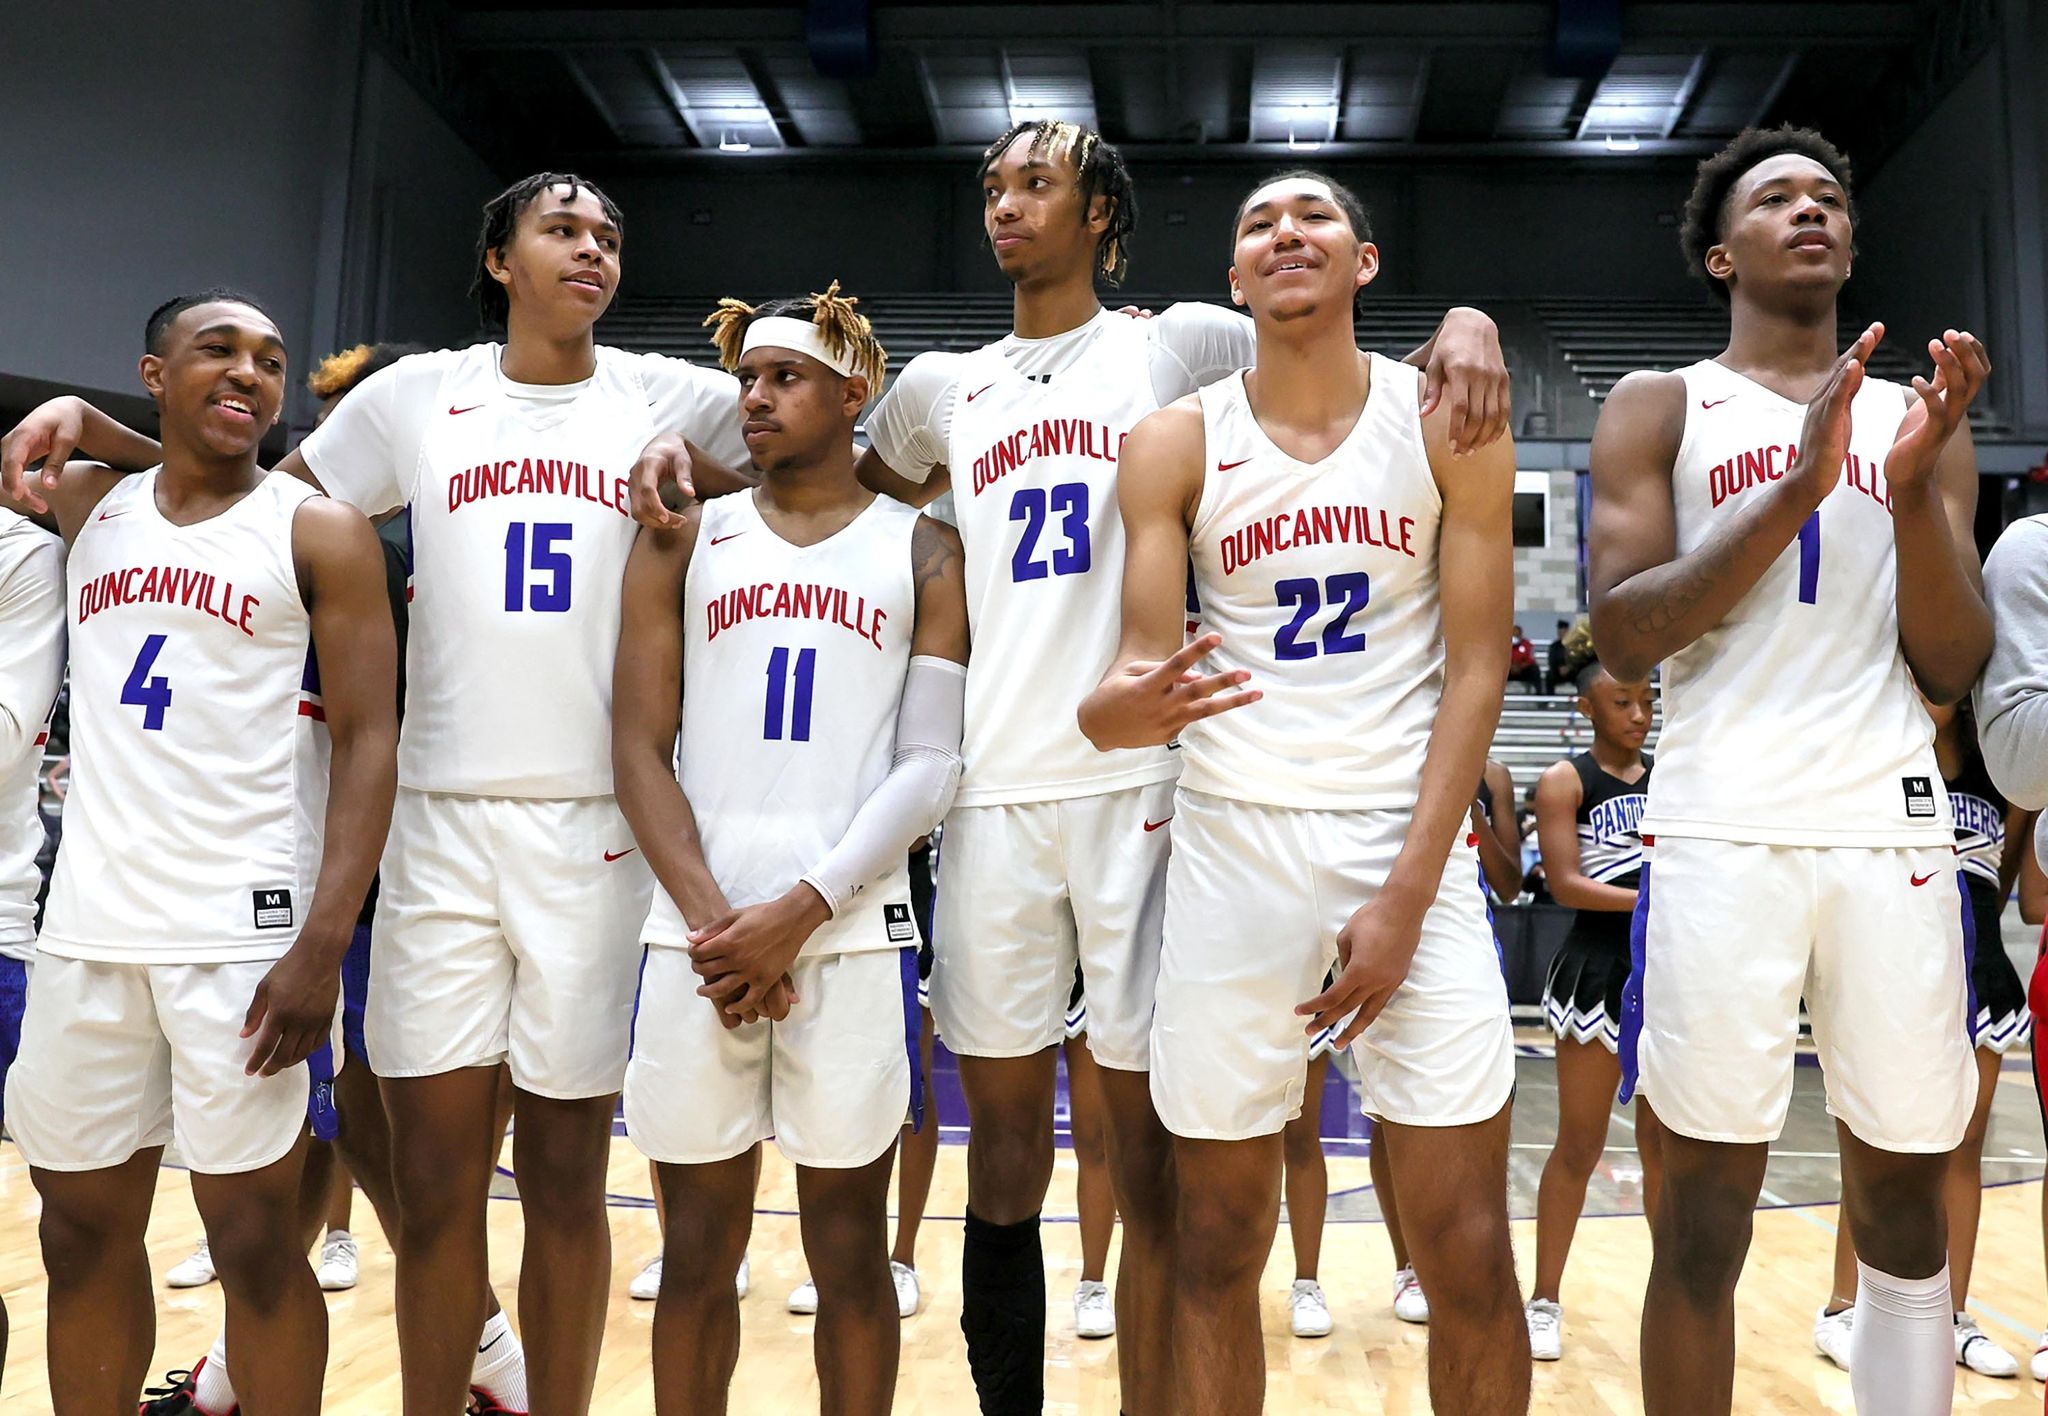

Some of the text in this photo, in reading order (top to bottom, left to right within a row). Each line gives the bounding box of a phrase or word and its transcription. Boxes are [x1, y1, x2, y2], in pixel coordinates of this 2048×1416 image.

[448, 457, 630, 518] DUNCANVILLE
[1709, 444, 1893, 518] DUNCAILL
[504, 521, 573, 612] 15
[1010, 483, 1091, 583] 23
[1220, 505, 1416, 577] DUNCANVILLE
[1797, 510, 1821, 605] 1
[79, 565, 260, 638] DUNCANVILLE
[707, 582, 888, 651] DUNCANVILLE
[1273, 571, 1370, 661] 22
[120, 634, 173, 731] 4
[763, 646, 817, 742] 11
[1912, 780, 1925, 793] M
[265, 893, 281, 906] M
